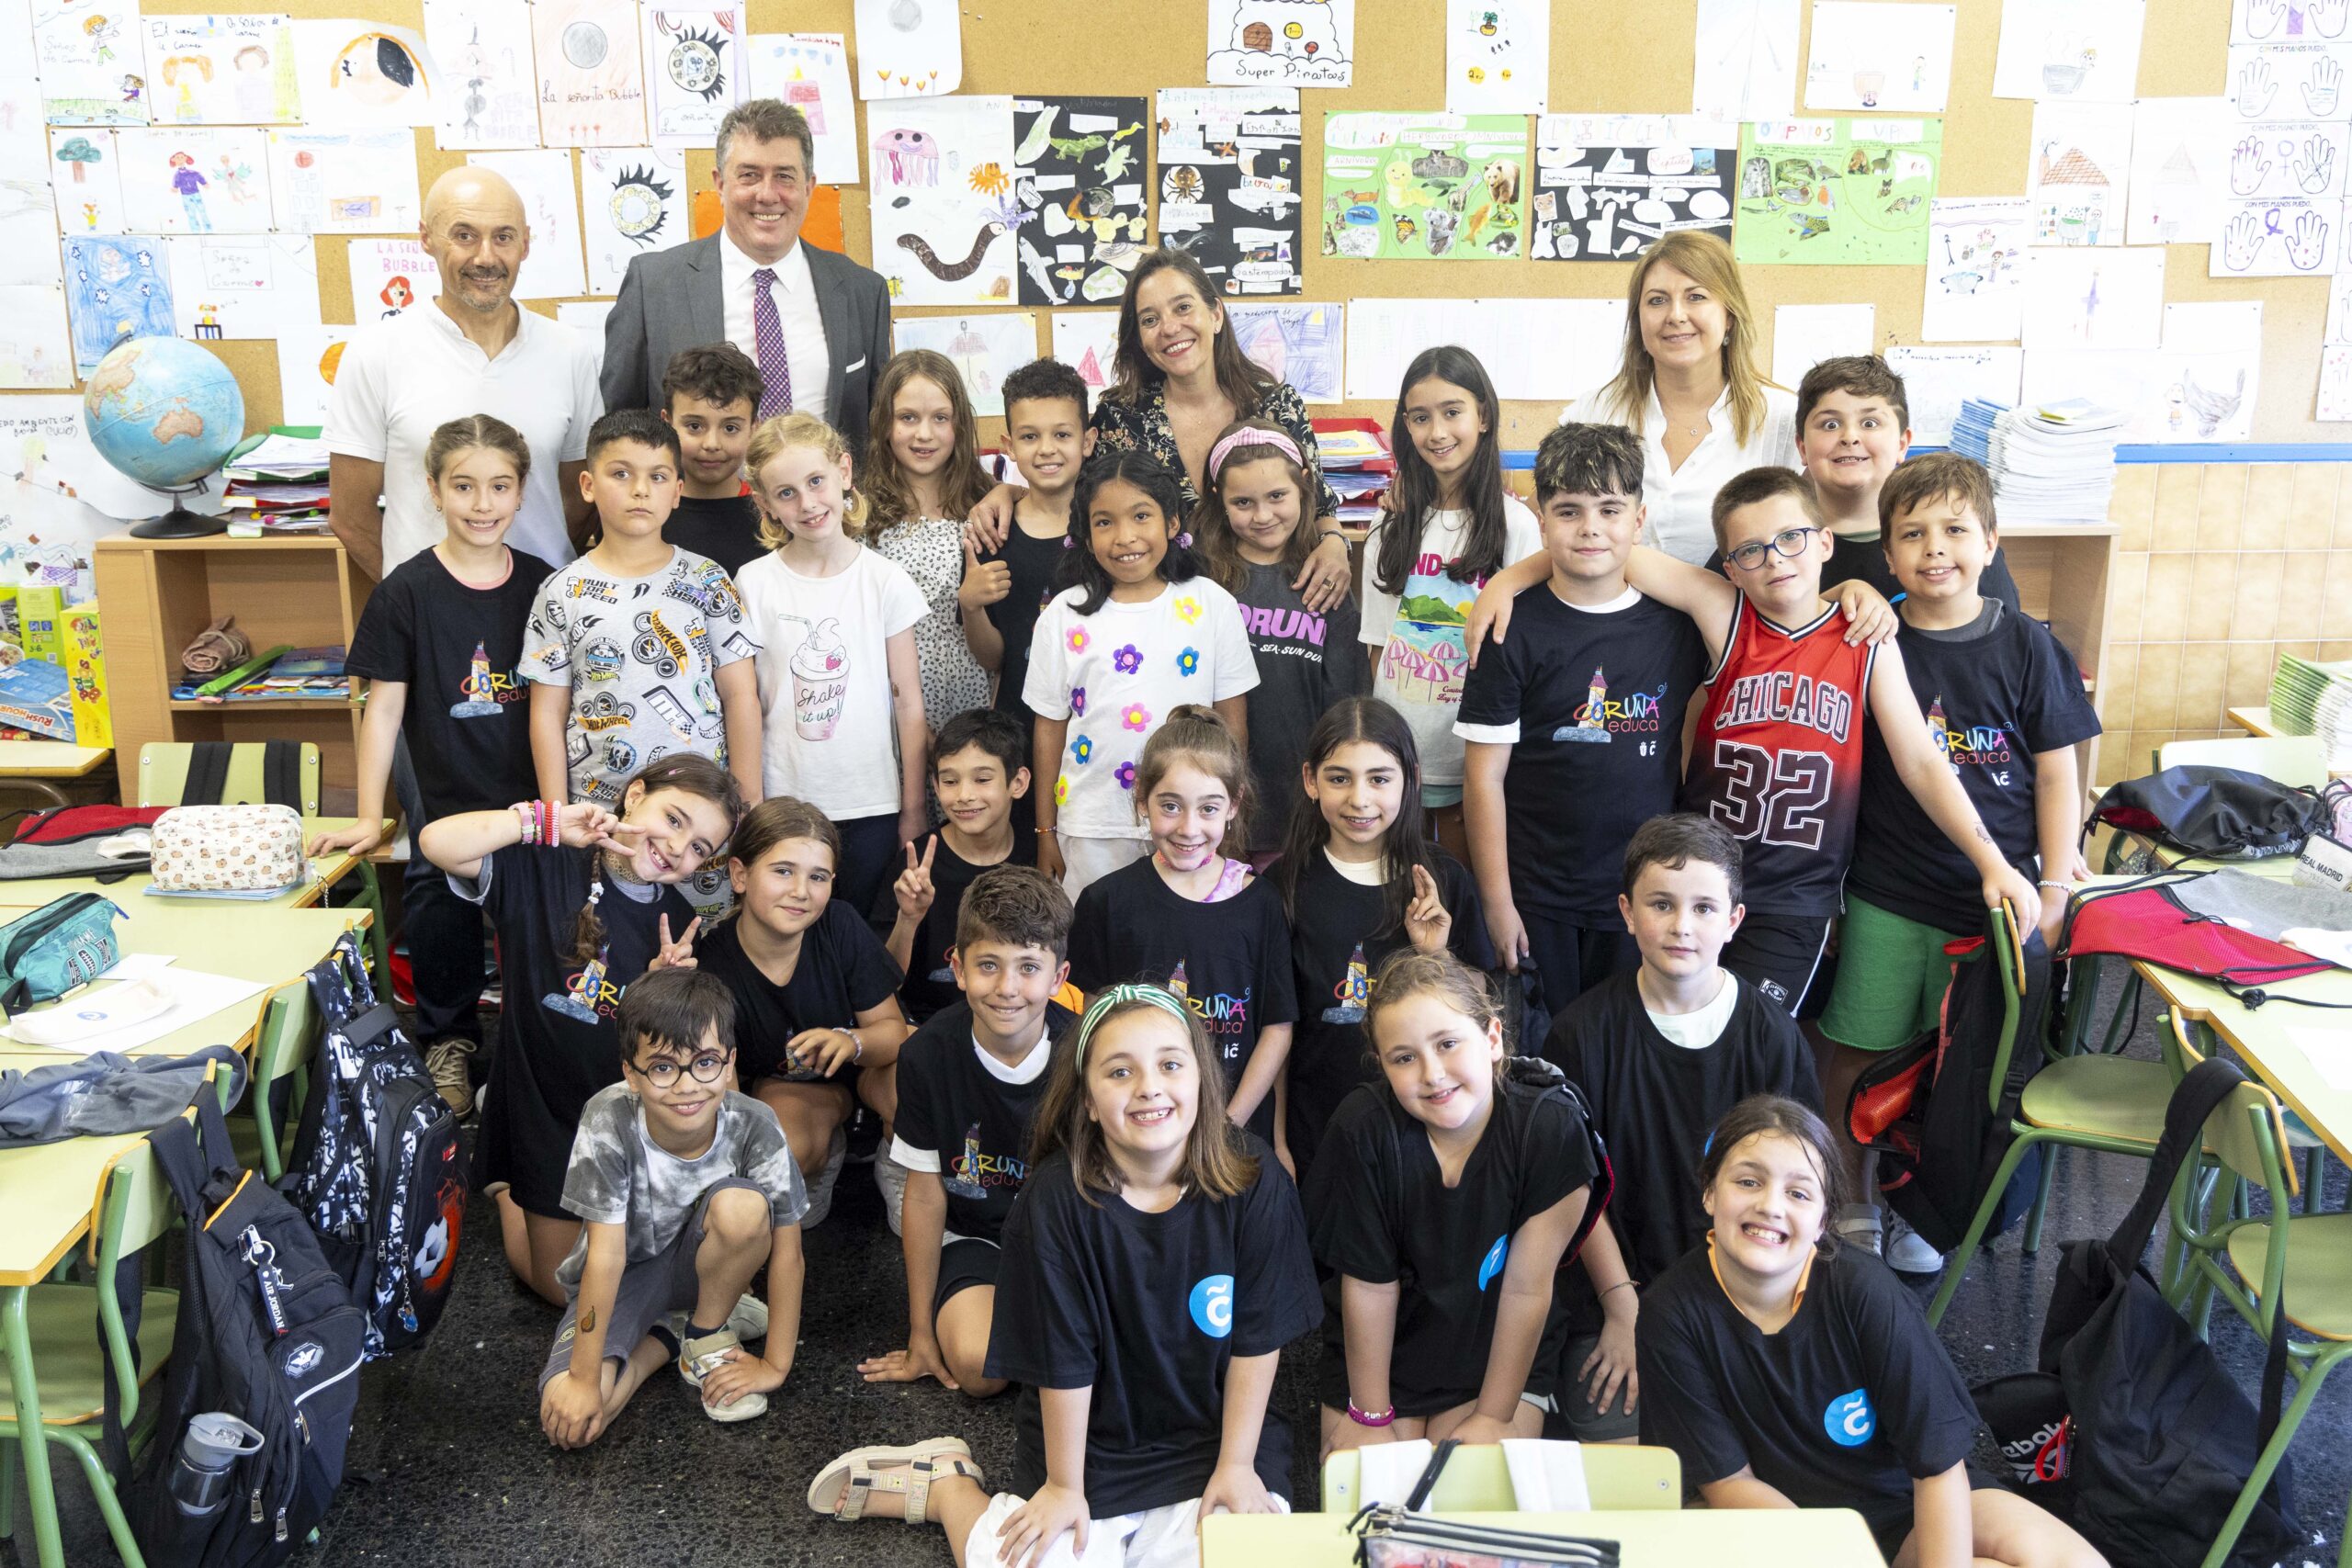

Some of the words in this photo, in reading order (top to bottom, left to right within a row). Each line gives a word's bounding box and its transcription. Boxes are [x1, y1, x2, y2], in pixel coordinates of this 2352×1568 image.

[1236, 59, 1275, 78] Super
[1283, 62, 1346, 82] Piratas
[542, 80, 558, 104] La
[567, 85, 604, 103] señorita
[382, 257, 436, 273] BUBBLE
[583, 578, 620, 590] BUILT
[797, 683, 845, 707] Shake
[802, 712, 814, 723] it
[817, 698, 842, 722] up!
[1714, 671, 1852, 745] CHICAGO
[26, 713, 53, 728] RUSH
[1608, 710, 1660, 733] educa
[1954, 750, 2010, 764] educa
[1710, 739, 1835, 851] 32
[2300, 853, 2316, 869] REAL
[2315, 862, 2344, 883] MADRID
[1204, 1010, 1242, 1034] duca
[264, 1280, 275, 1295] AIR
[267, 1295, 285, 1329] JORDAN
